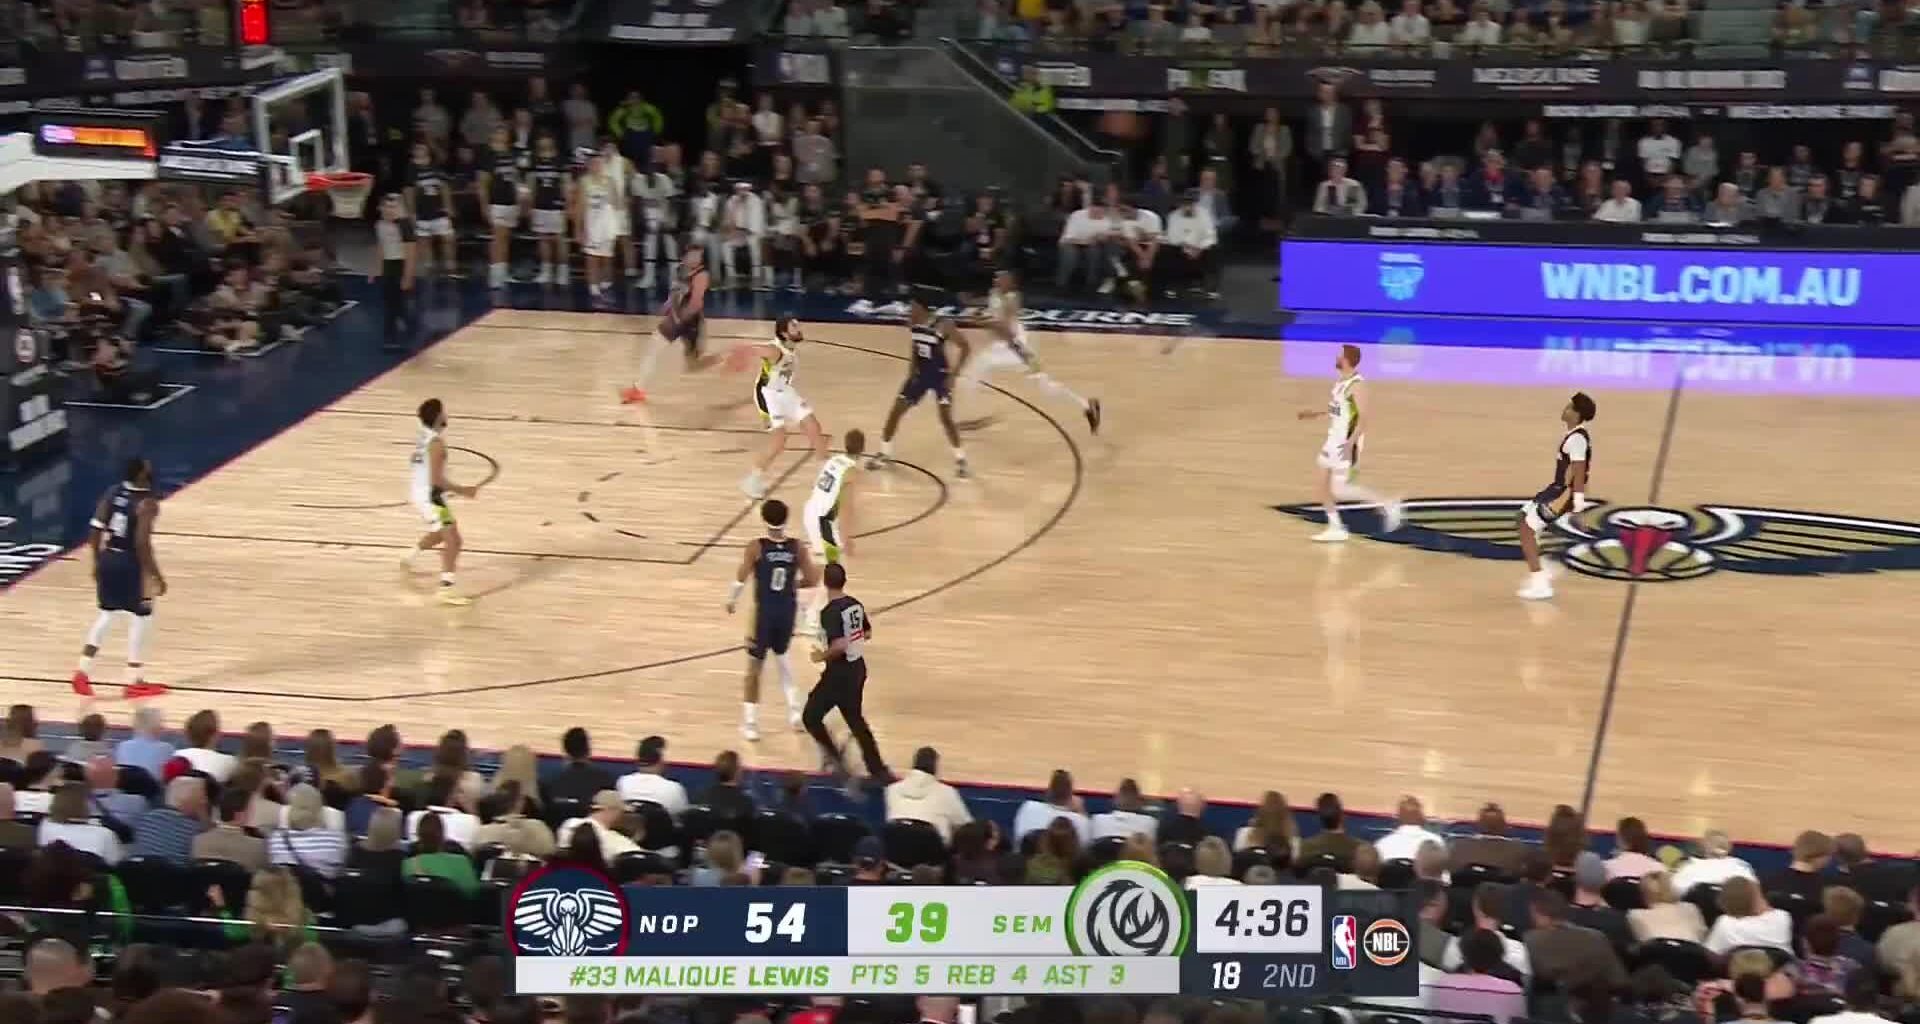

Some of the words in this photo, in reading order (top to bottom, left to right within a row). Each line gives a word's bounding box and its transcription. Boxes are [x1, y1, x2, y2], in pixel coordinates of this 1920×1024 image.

[1541, 262, 1862, 307] WNBL.COM.AU
[770, 567, 786, 591] 0
[850, 609, 861, 629] 15
